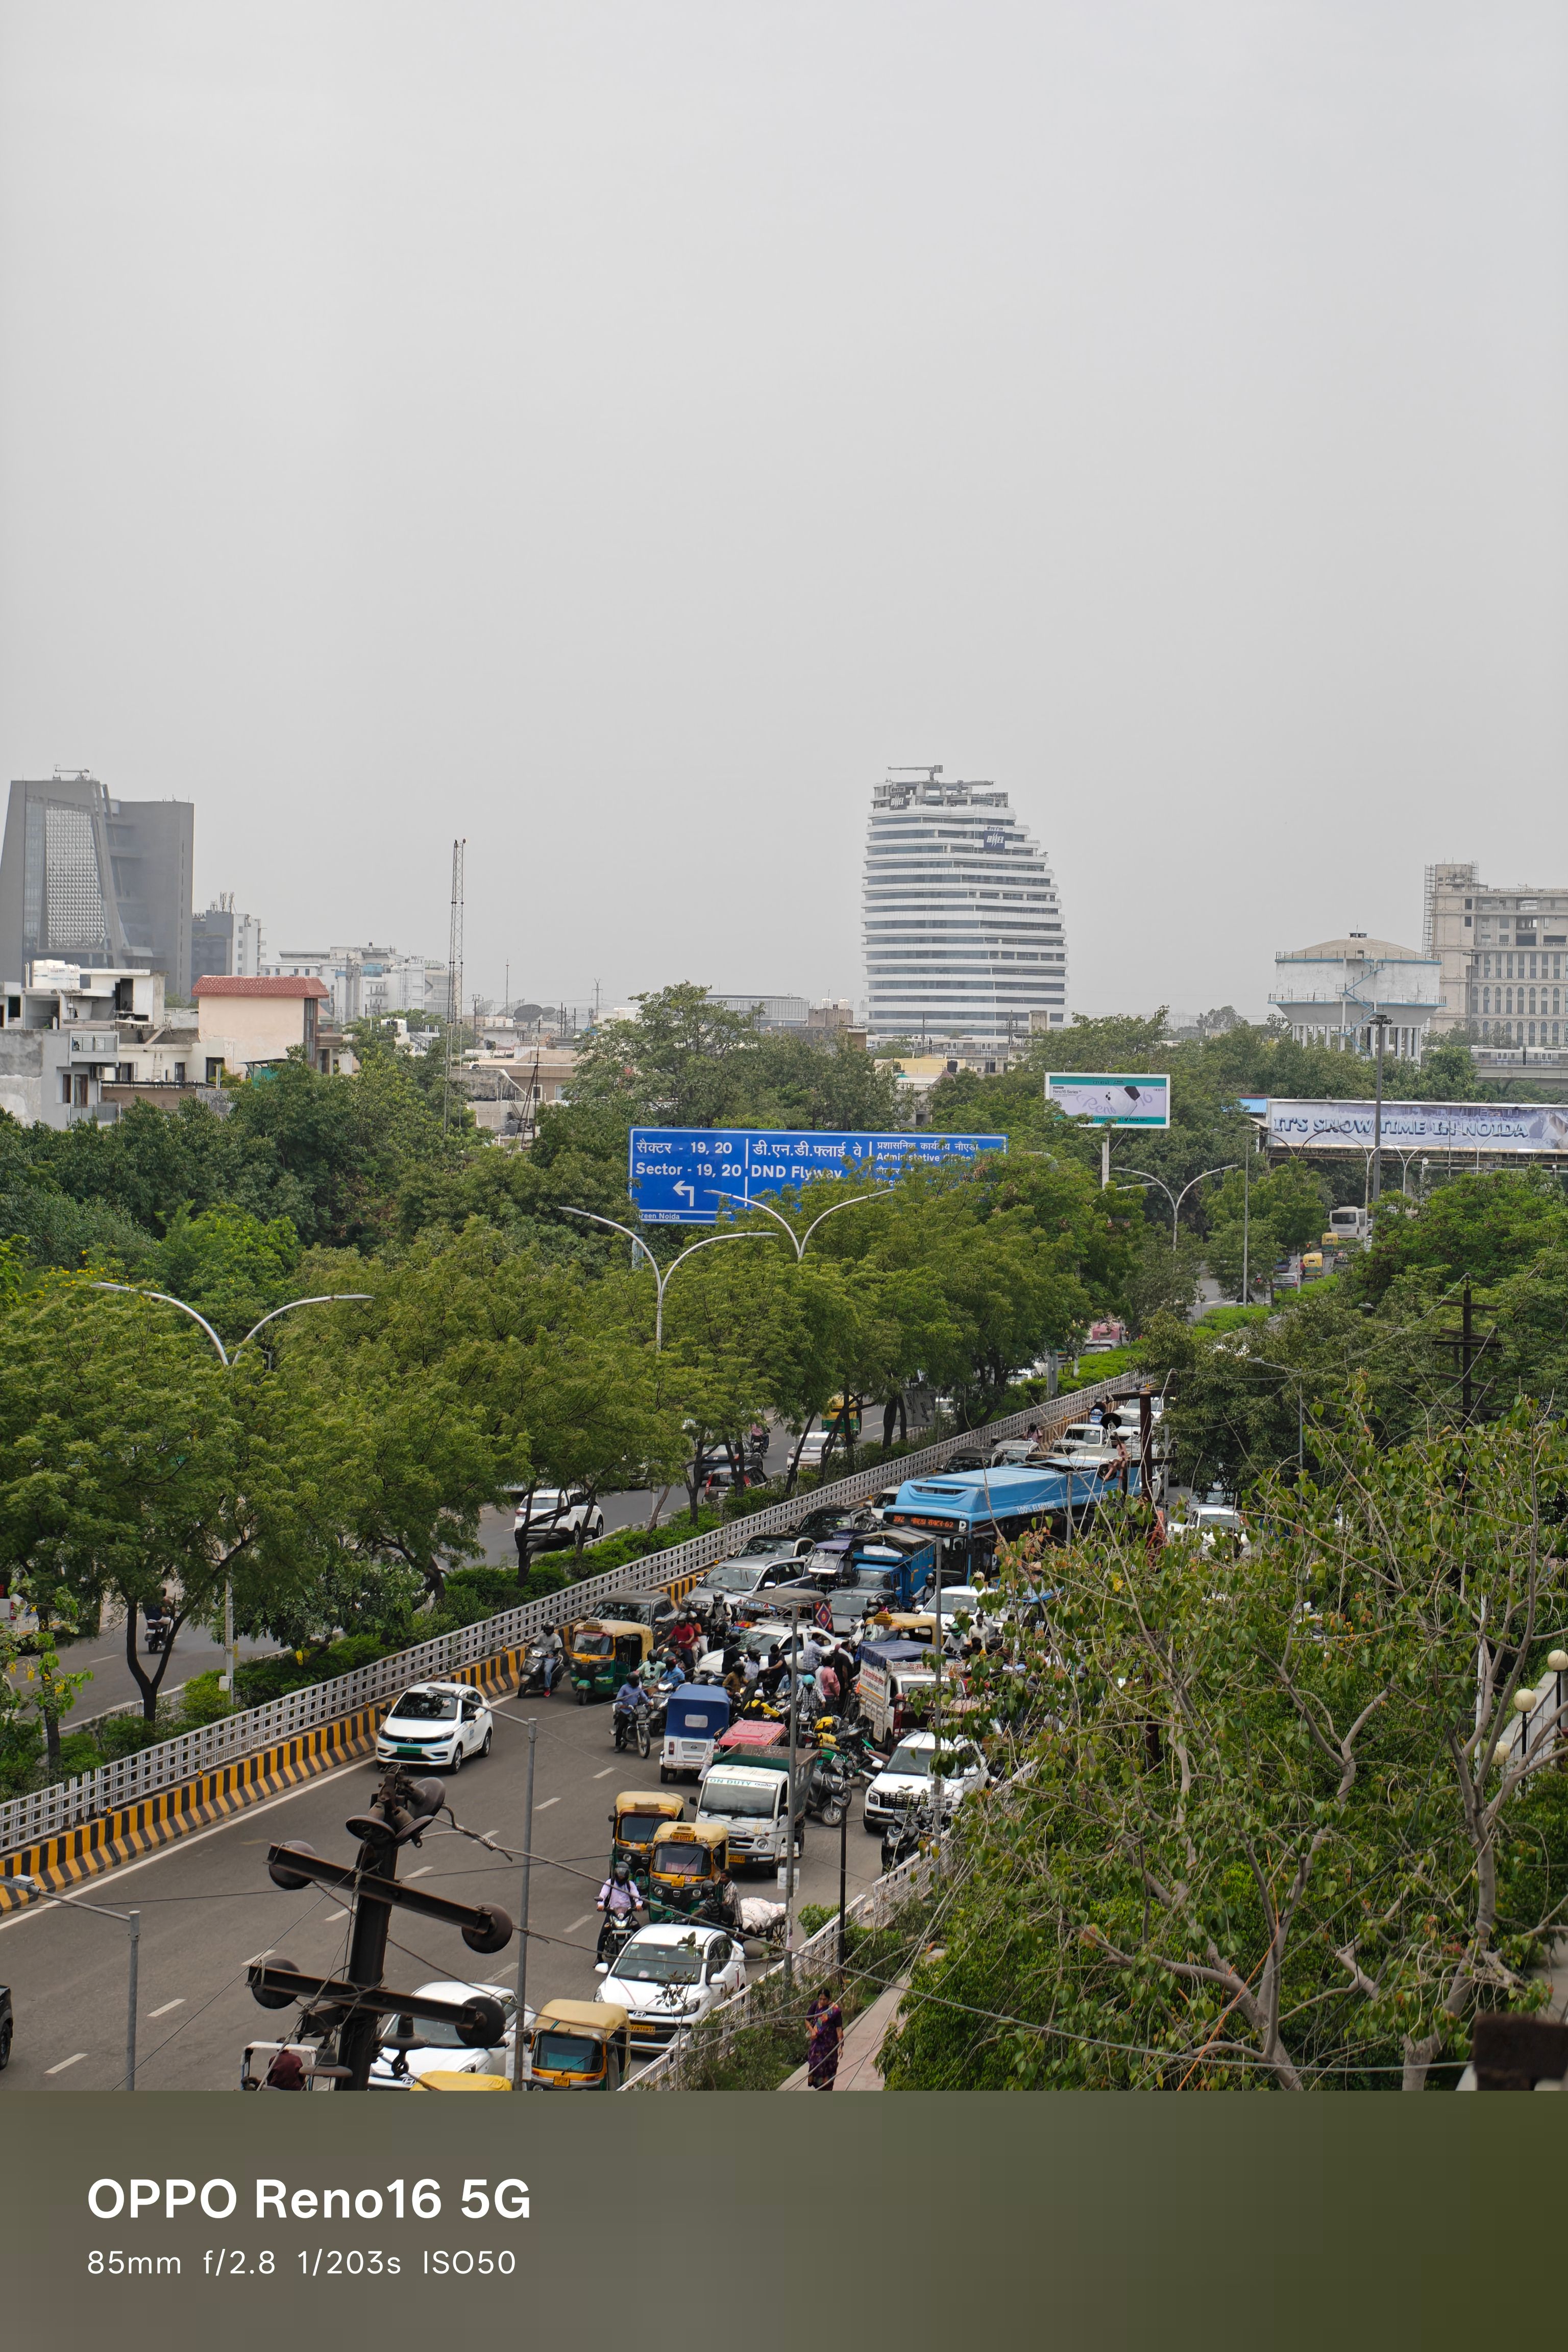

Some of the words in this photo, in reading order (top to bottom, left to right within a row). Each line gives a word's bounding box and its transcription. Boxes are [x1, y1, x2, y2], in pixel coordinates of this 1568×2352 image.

[987, 833, 1004, 846] BHEL
[1274, 1117, 1308, 1132] IT'S
[1313, 1118, 1373, 1134] SNOW
[1380, 1119, 1426, 1135] TIME
[1433, 1120, 1456, 1136] IN
[1462, 1121, 1529, 1138] NOIDA
[636, 1138, 672, 1154] सैक्टर
[691, 1141, 709, 1155] 19,
[715, 1142, 732, 1154] 20
[853, 1142, 862, 1157] वे
[877, 1140, 916, 1150] प्रशासनिक
[635, 1162, 683, 1175] Sector
[697, 1164, 716, 1178] 19,
[722, 1164, 742, 1177] 20
[751, 1165, 786, 1178] DND
[1017, 1506, 1032, 1514] 100%
[1032, 1502, 1057, 1512] ELECTRIC
